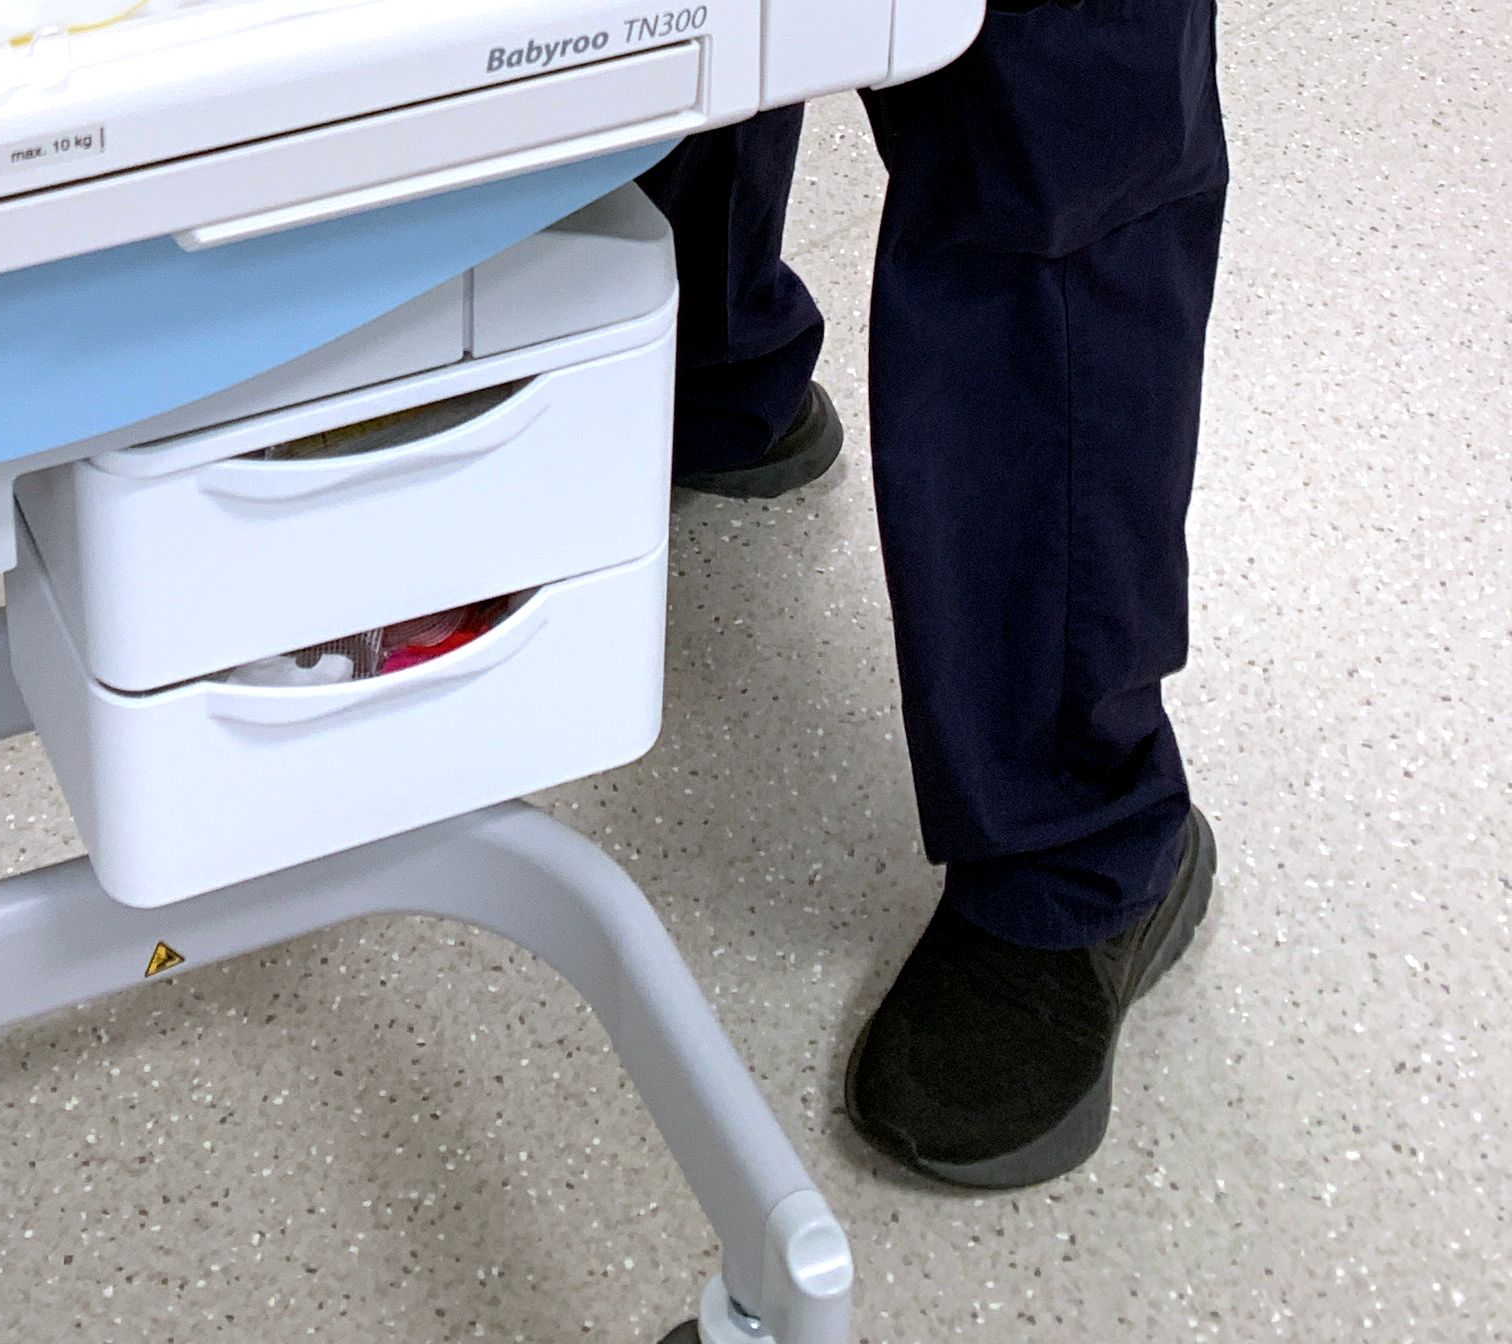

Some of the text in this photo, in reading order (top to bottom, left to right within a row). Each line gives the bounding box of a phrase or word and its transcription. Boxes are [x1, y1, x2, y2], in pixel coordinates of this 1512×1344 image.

[486, 5, 708, 73] Babyroo TN300
[11, 135, 93, 163] max. 10 kg
